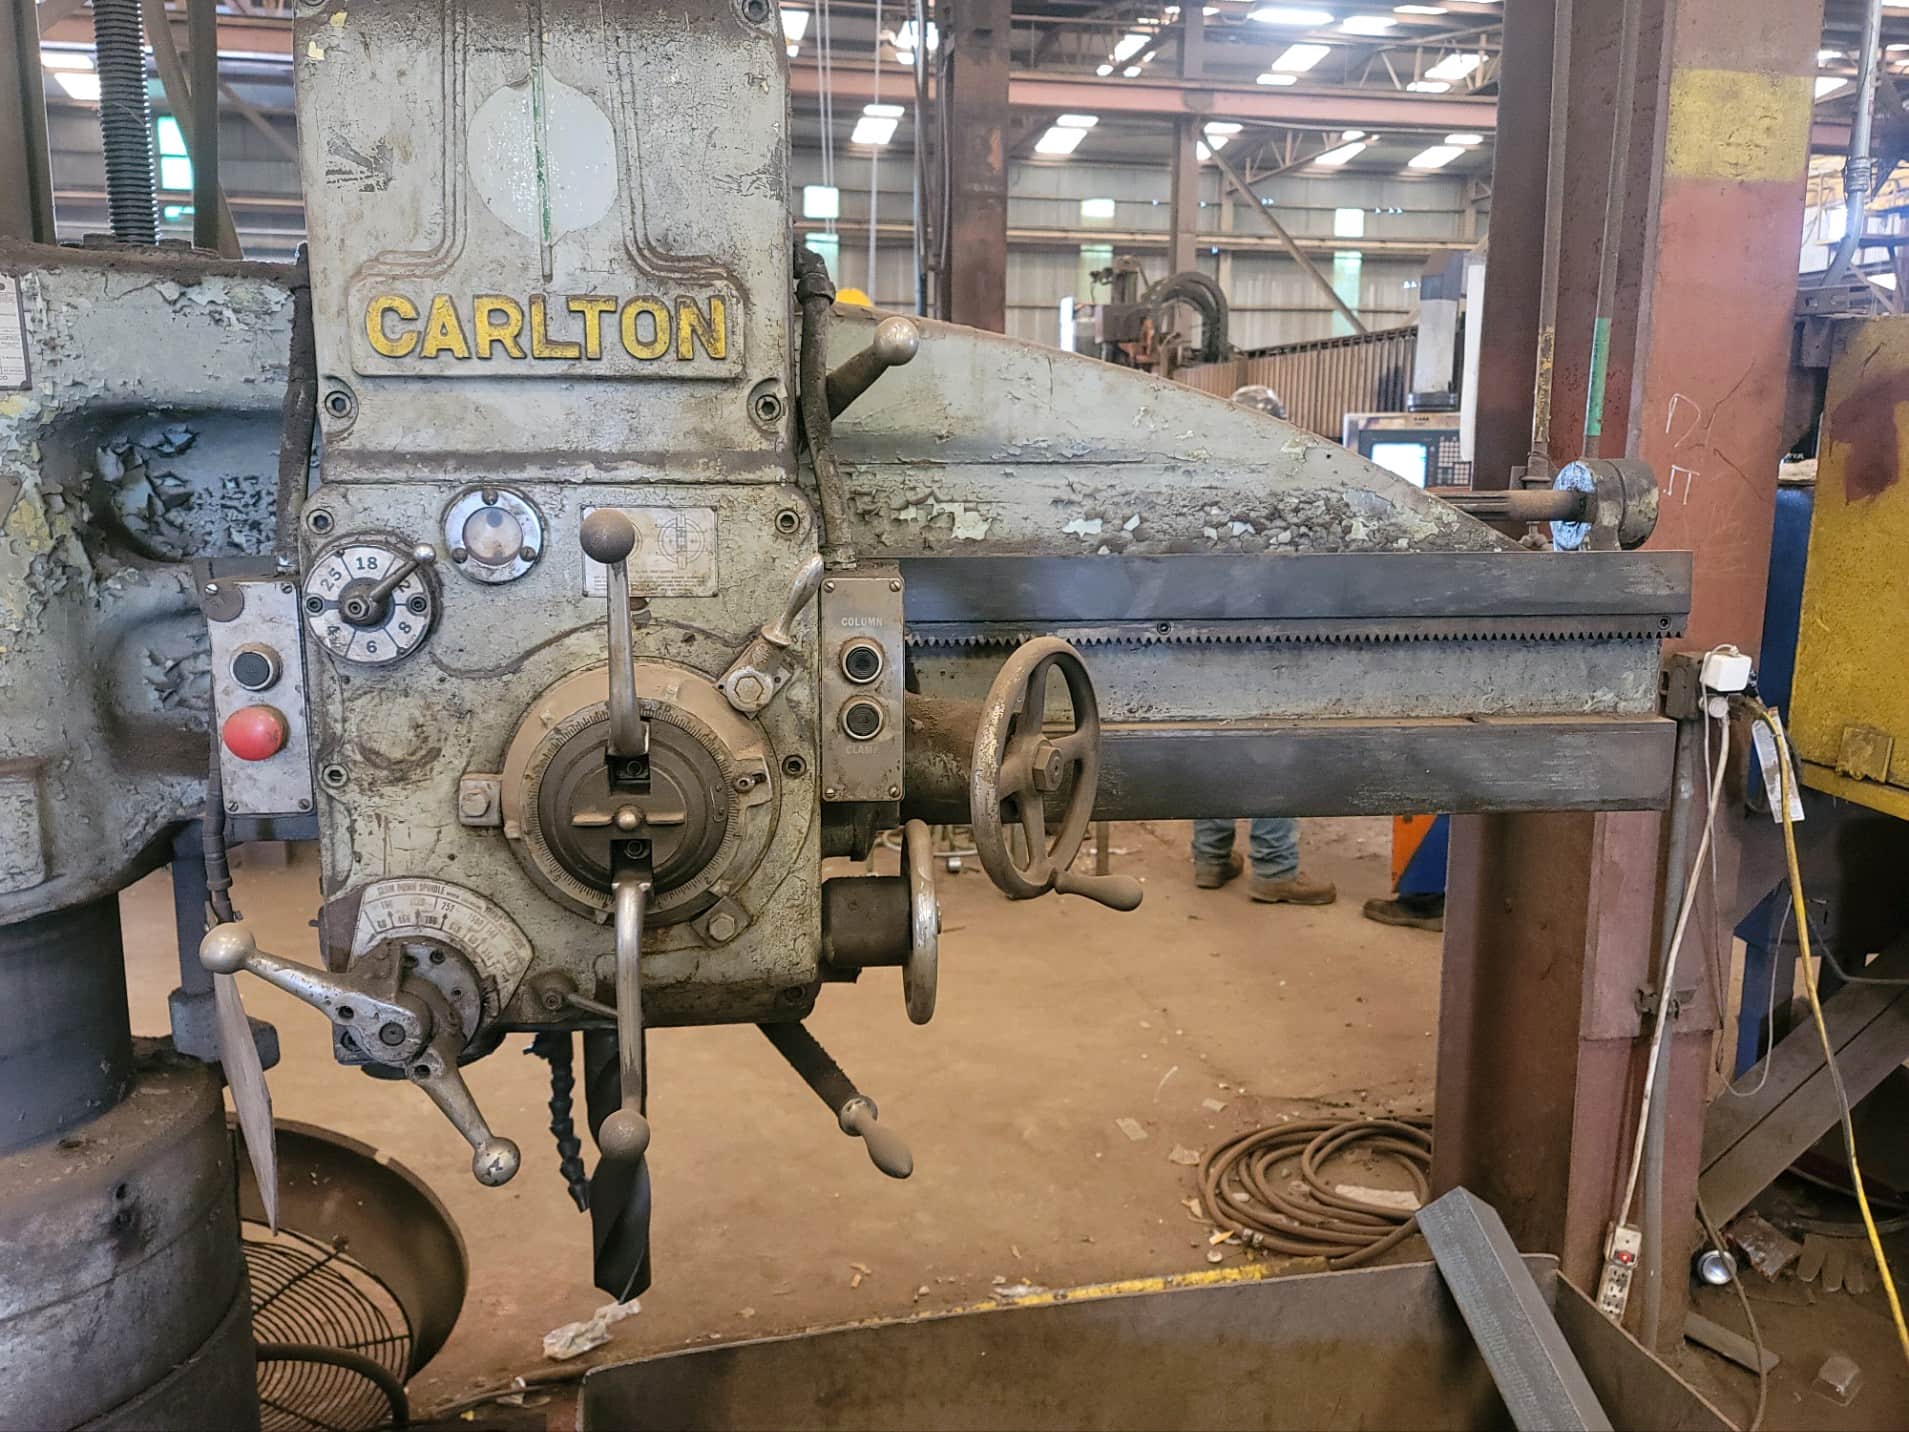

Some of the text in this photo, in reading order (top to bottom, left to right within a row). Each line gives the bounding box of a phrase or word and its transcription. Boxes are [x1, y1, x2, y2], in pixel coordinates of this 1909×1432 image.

[364, 293, 727, 360] CARLTON
[354, 556, 378, 570] 18
[320, 567, 342, 592] 25
[398, 621, 412, 634] 8
[841, 615, 883, 627] COLUMN
[366, 640, 378, 653] 6
